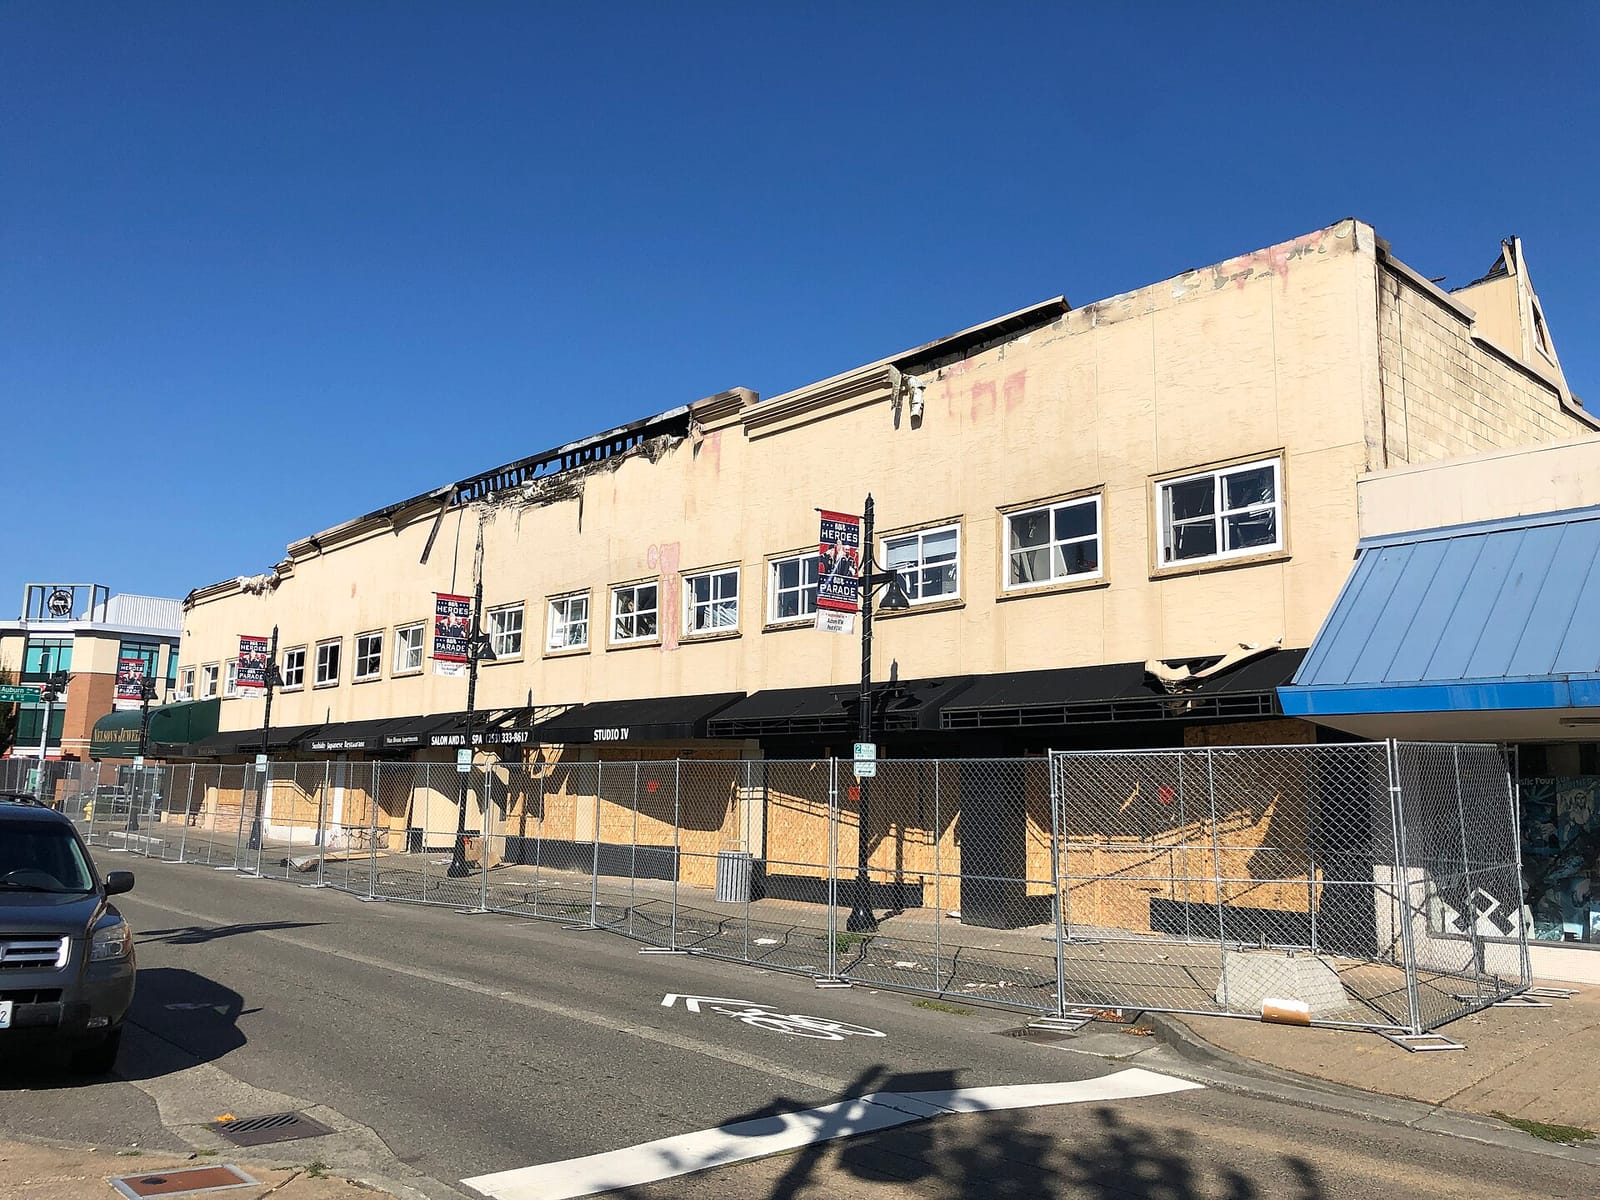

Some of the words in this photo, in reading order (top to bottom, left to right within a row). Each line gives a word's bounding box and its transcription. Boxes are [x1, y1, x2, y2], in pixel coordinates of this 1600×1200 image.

[821, 528, 858, 543] HEROES
[820, 583, 856, 597] PARADE
[437, 605, 469, 615] HEROES
[436, 642, 466, 652] PARADE
[1, 686, 25, 694] Auburn
[118, 727, 141, 743] JEWEL
[430, 735, 448, 746] SALON
[448, 735, 460, 745] AND
[471, 733, 483, 745] SPA
[501, 731, 529, 744] 333-8617
[593, 728, 620, 741] STUDIO
[620, 727, 629, 740] IV
